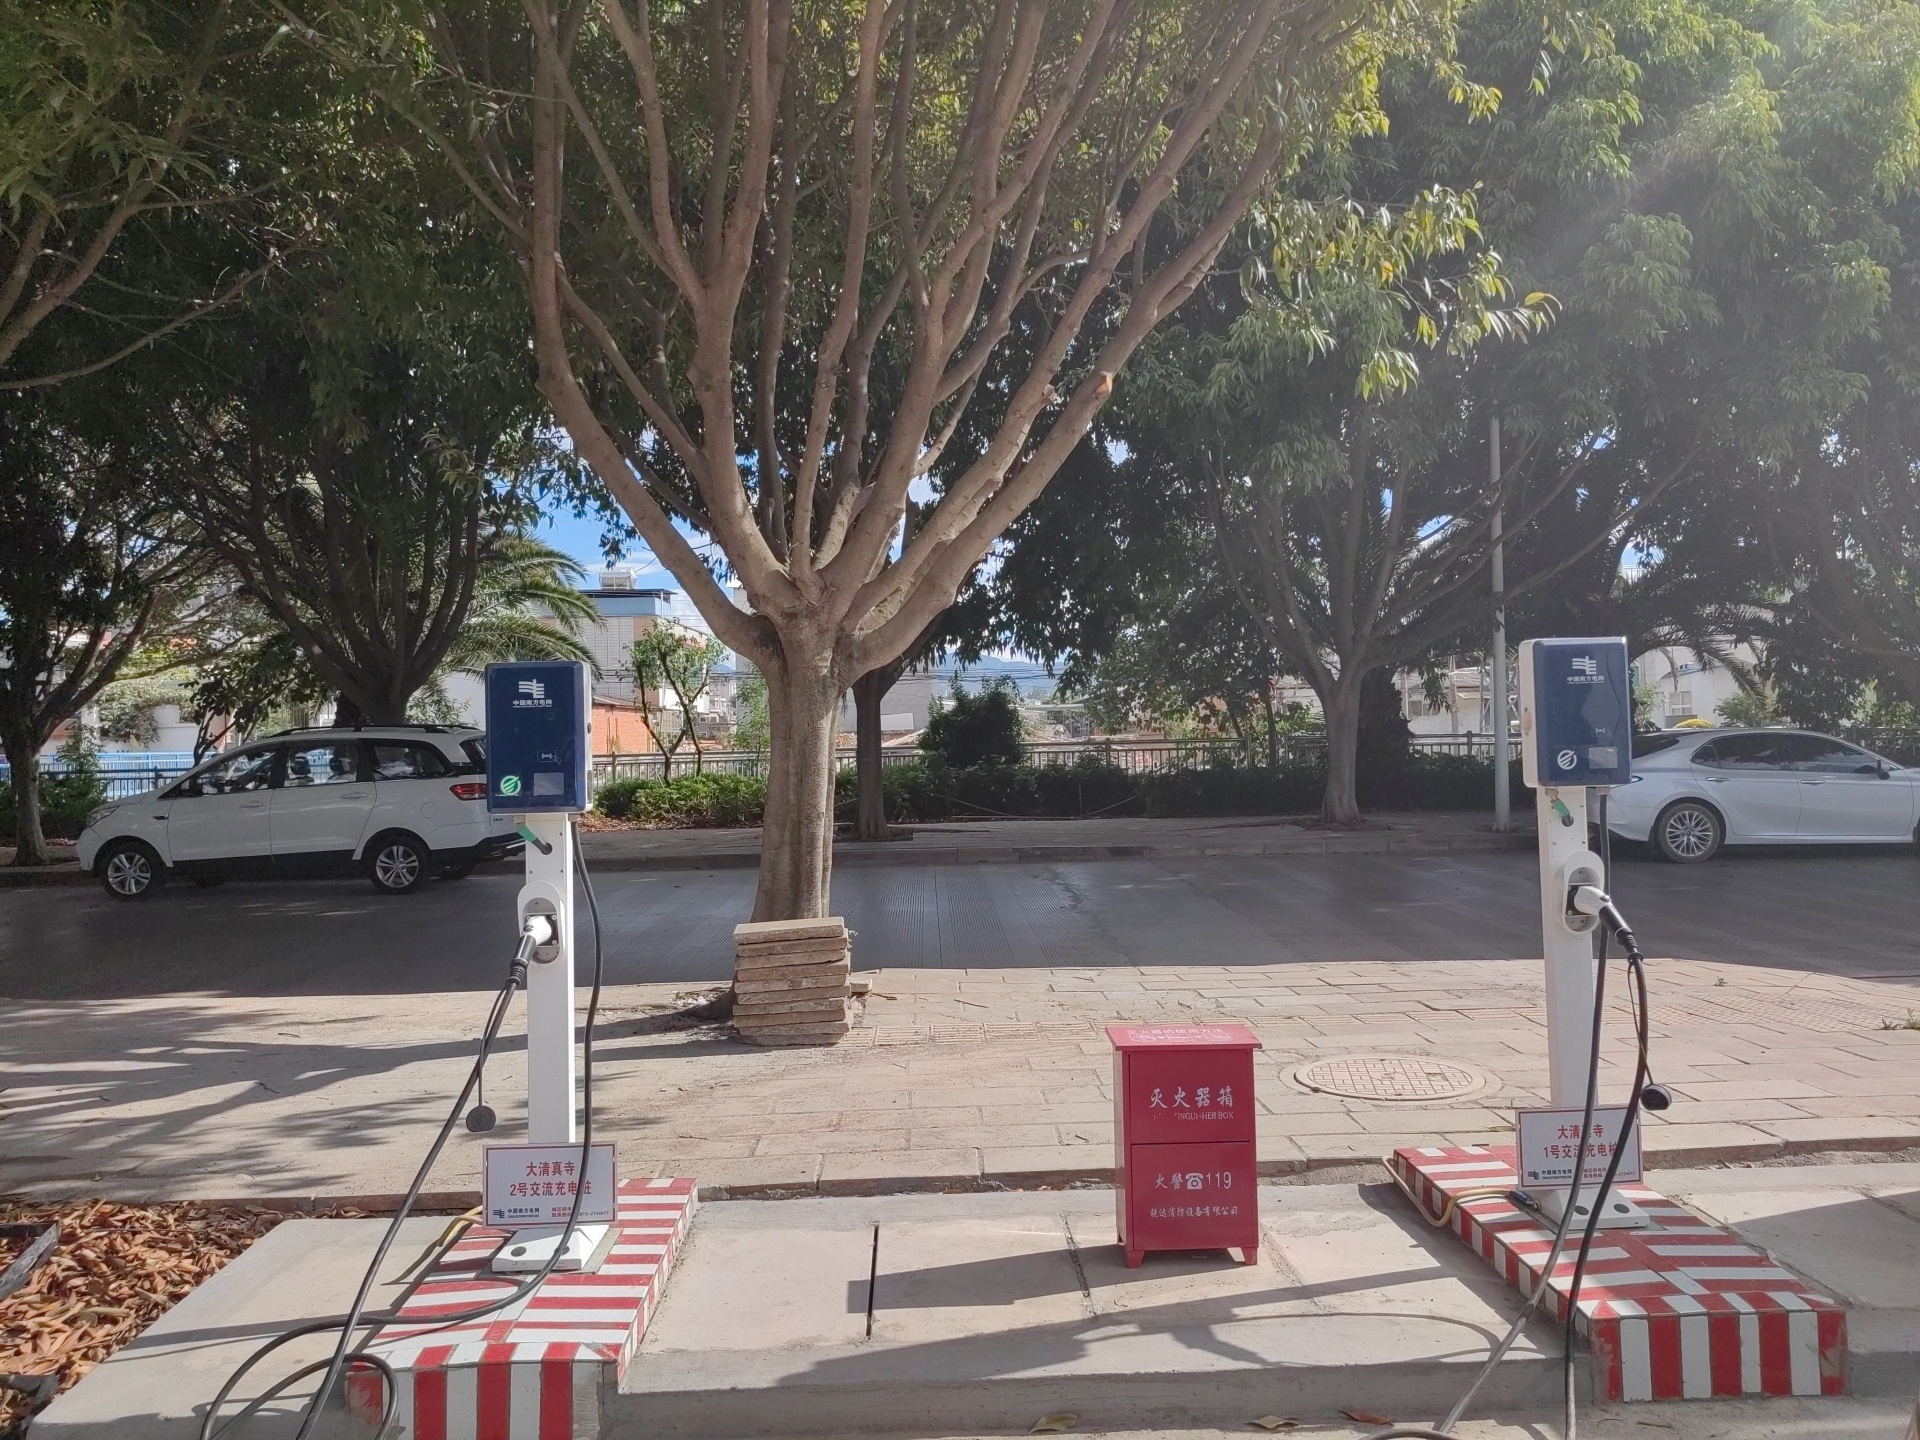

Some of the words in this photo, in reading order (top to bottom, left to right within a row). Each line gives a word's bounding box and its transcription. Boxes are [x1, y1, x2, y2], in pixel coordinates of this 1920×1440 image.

[1149, 1085, 1233, 1108] 灭火器箱
[1218, 1111, 1234, 1120] BOX
[1557, 1123, 1604, 1140] 大清寺
[526, 1160, 576, 1177] 大清真寺
[1154, 1172, 1184, 1190] 火警
[1205, 1171, 1232, 1189] 119
